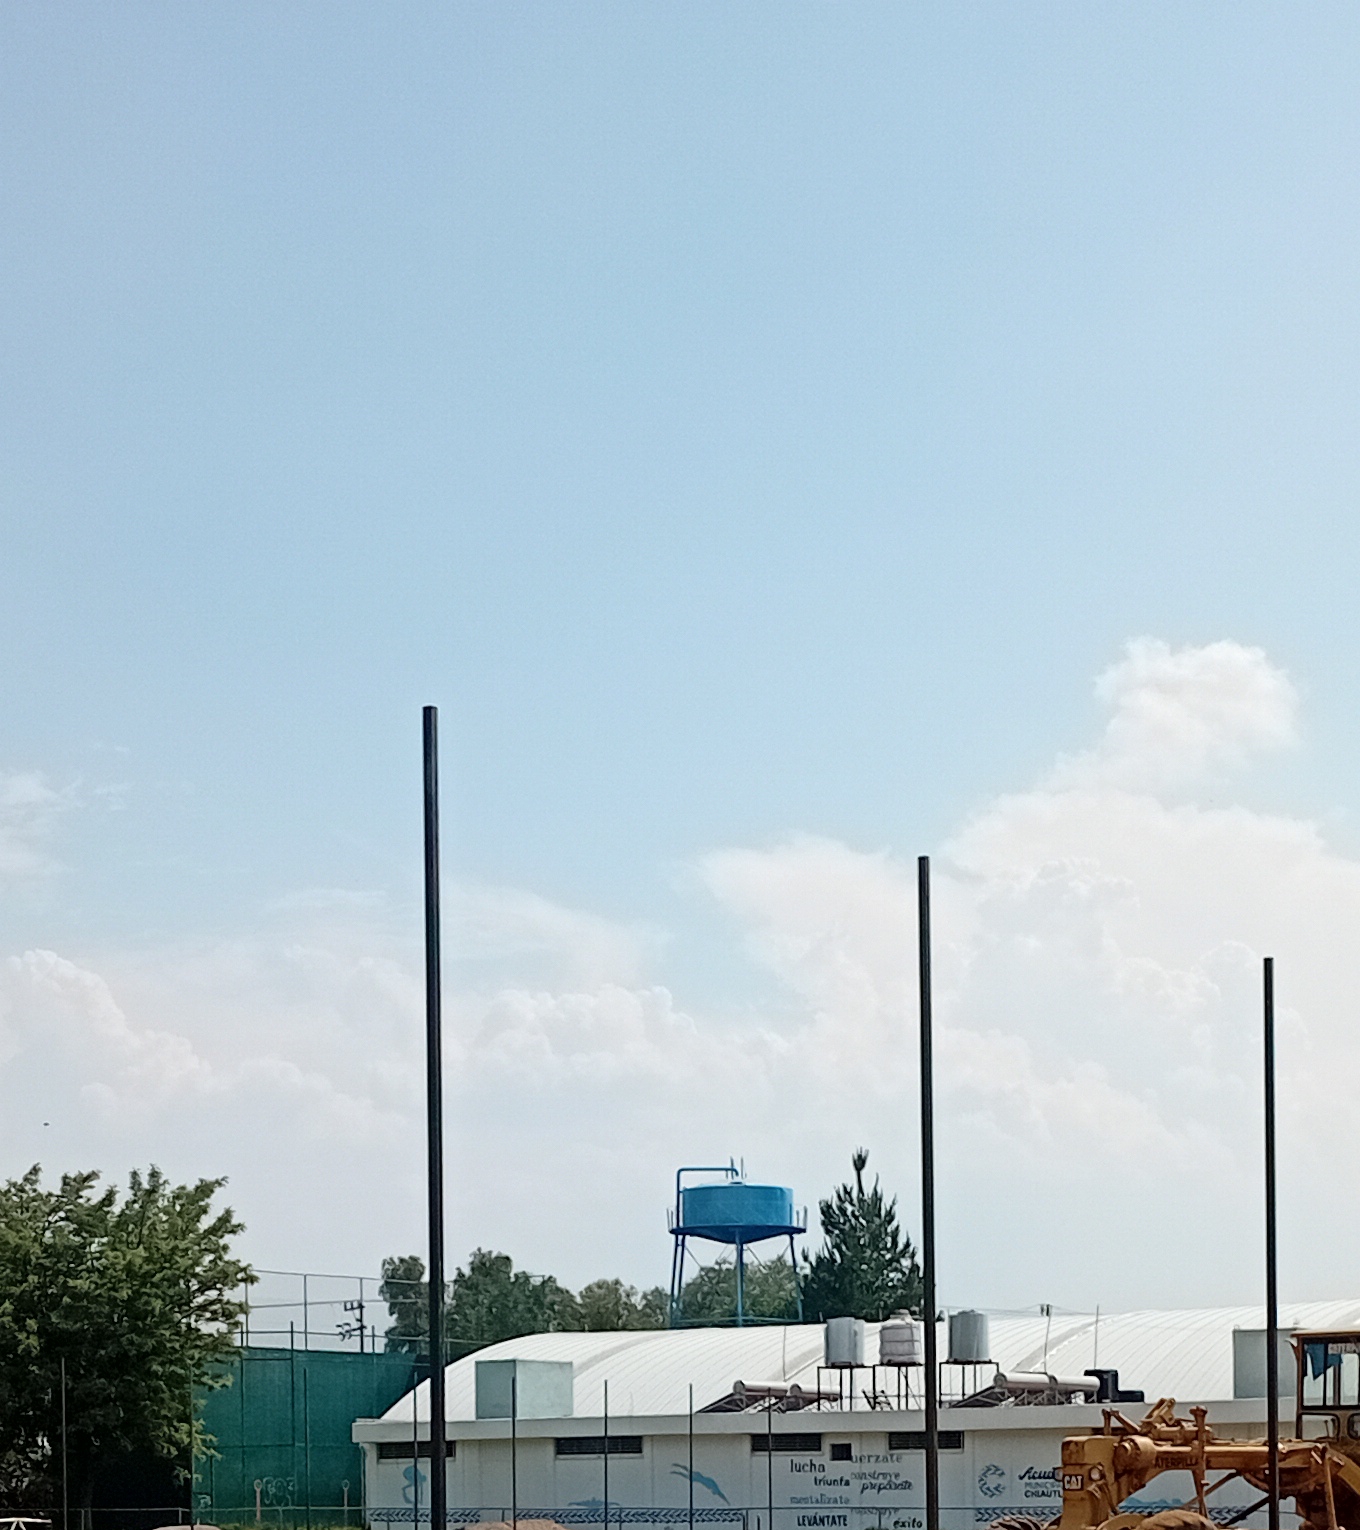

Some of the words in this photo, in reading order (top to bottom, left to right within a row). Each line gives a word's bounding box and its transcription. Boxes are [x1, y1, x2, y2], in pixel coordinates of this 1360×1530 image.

[790, 1458, 826, 1473] lucha
[851, 1454, 903, 1464] uerzate
[814, 1475, 850, 1487] triunfa
[1064, 1475, 1083, 1490] CAT
[1024, 1490, 1064, 1498] CHIAUTL
[797, 1510, 848, 1527] LEVÁNTATE
[892, 1515, 923, 1529] éxito
